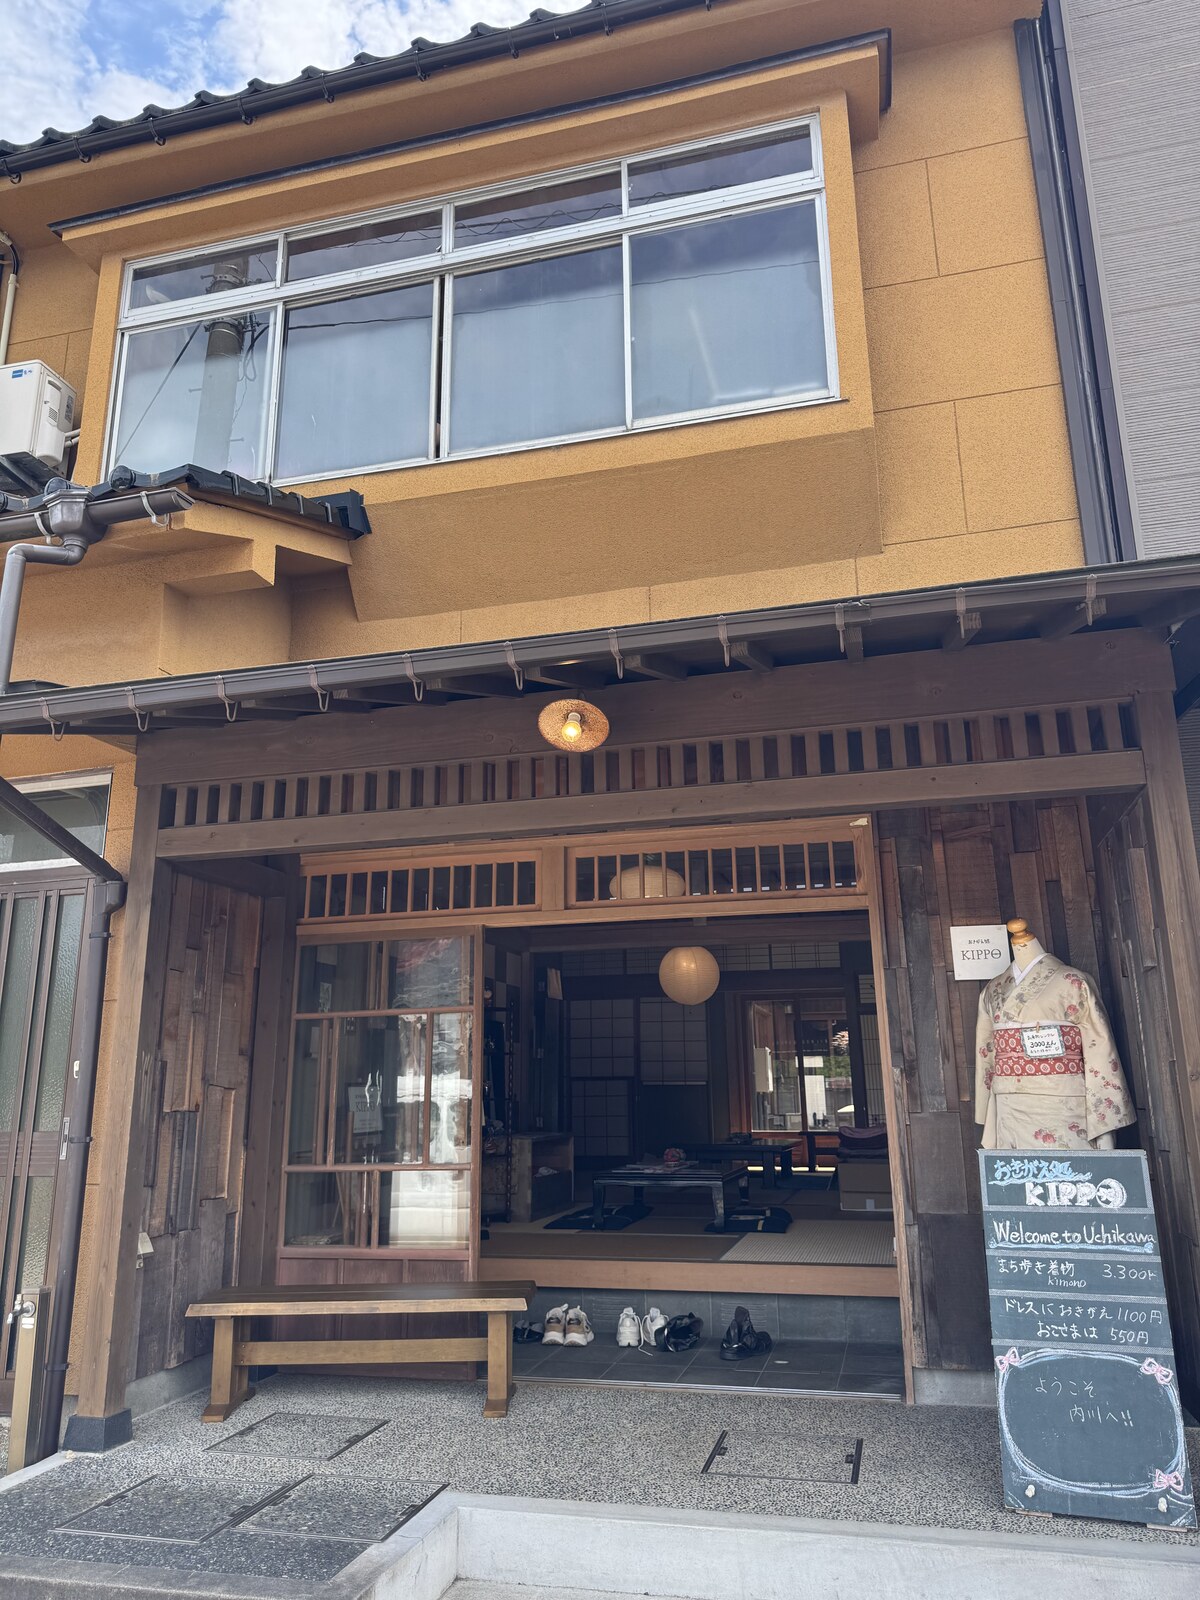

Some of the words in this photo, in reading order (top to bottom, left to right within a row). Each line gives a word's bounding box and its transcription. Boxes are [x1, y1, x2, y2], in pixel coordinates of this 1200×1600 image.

[993, 1220, 1061, 1244] Welcome
[1062, 1230, 1082, 1244] to
[1083, 1221, 1156, 1244] Uchikawa
[998, 1259, 1075, 1277] まち歩き着物
[1037, 1321, 1099, 1340] おこさまは
[1110, 1327, 1149, 1344] 550円
[1035, 1377, 1097, 1398] ようこそ
